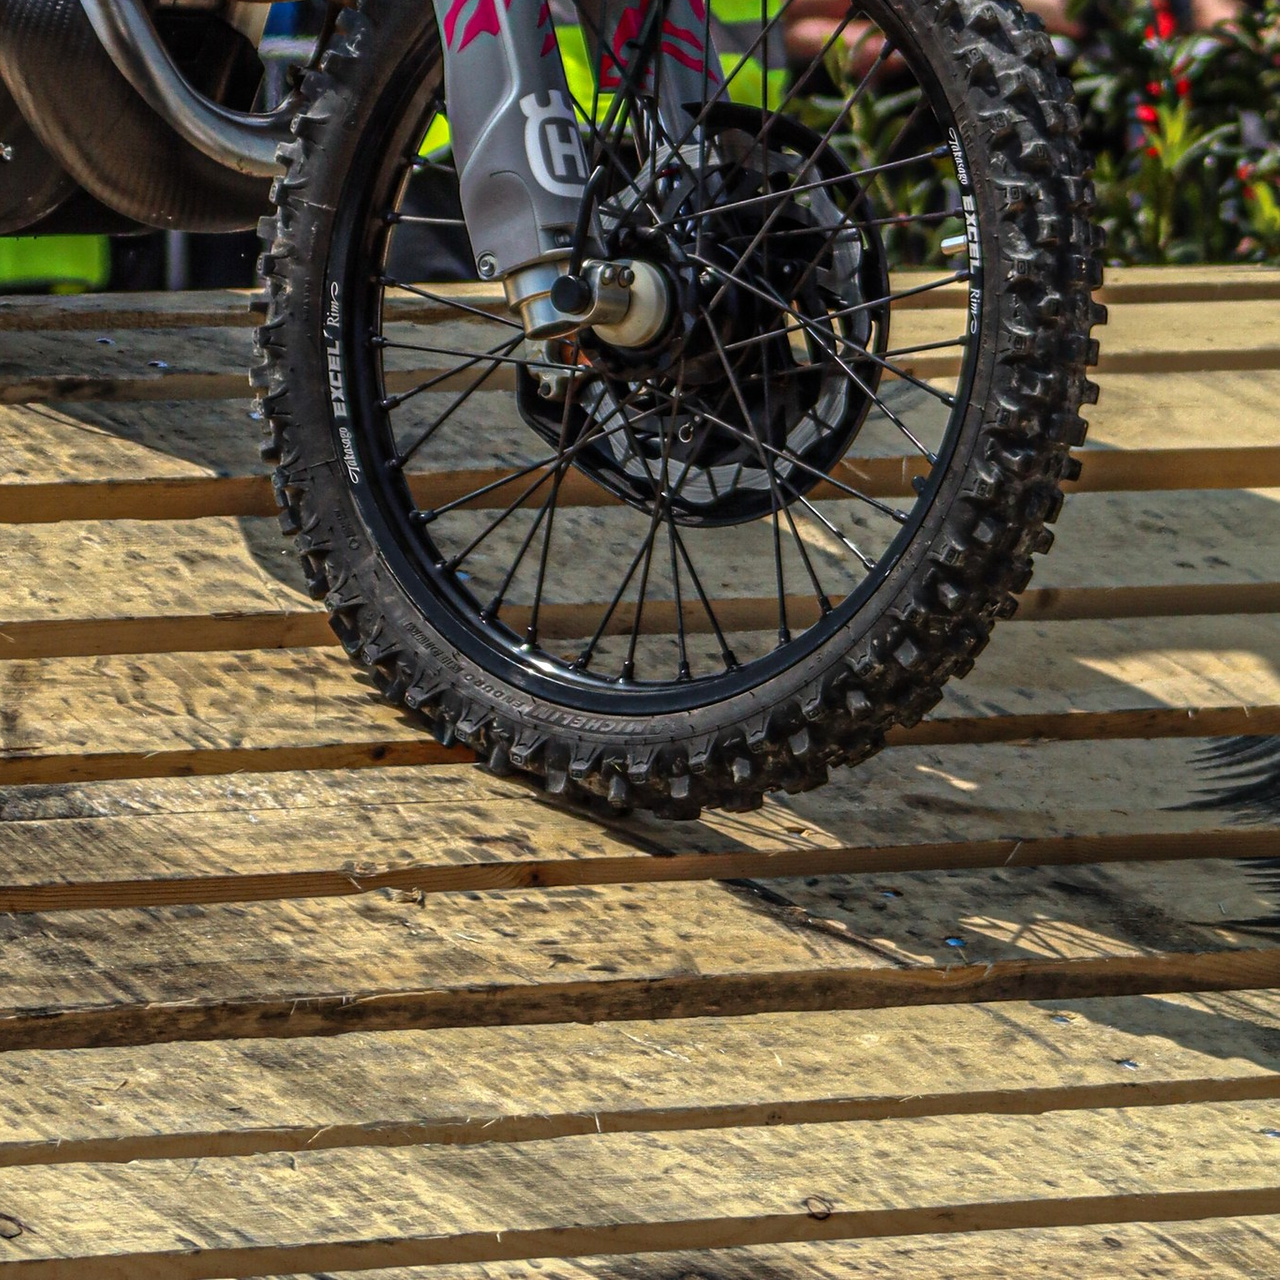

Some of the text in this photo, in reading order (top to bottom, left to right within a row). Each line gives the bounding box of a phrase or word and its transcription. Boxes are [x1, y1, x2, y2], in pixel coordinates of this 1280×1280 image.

[961, 194, 982, 276] EXCEL
[326, 340, 349, 418] EXCEL
[338, 426, 360, 485] Takasago
[462, 673, 524, 712] ENDURO
[528, 703, 652, 735] MICHELIN
